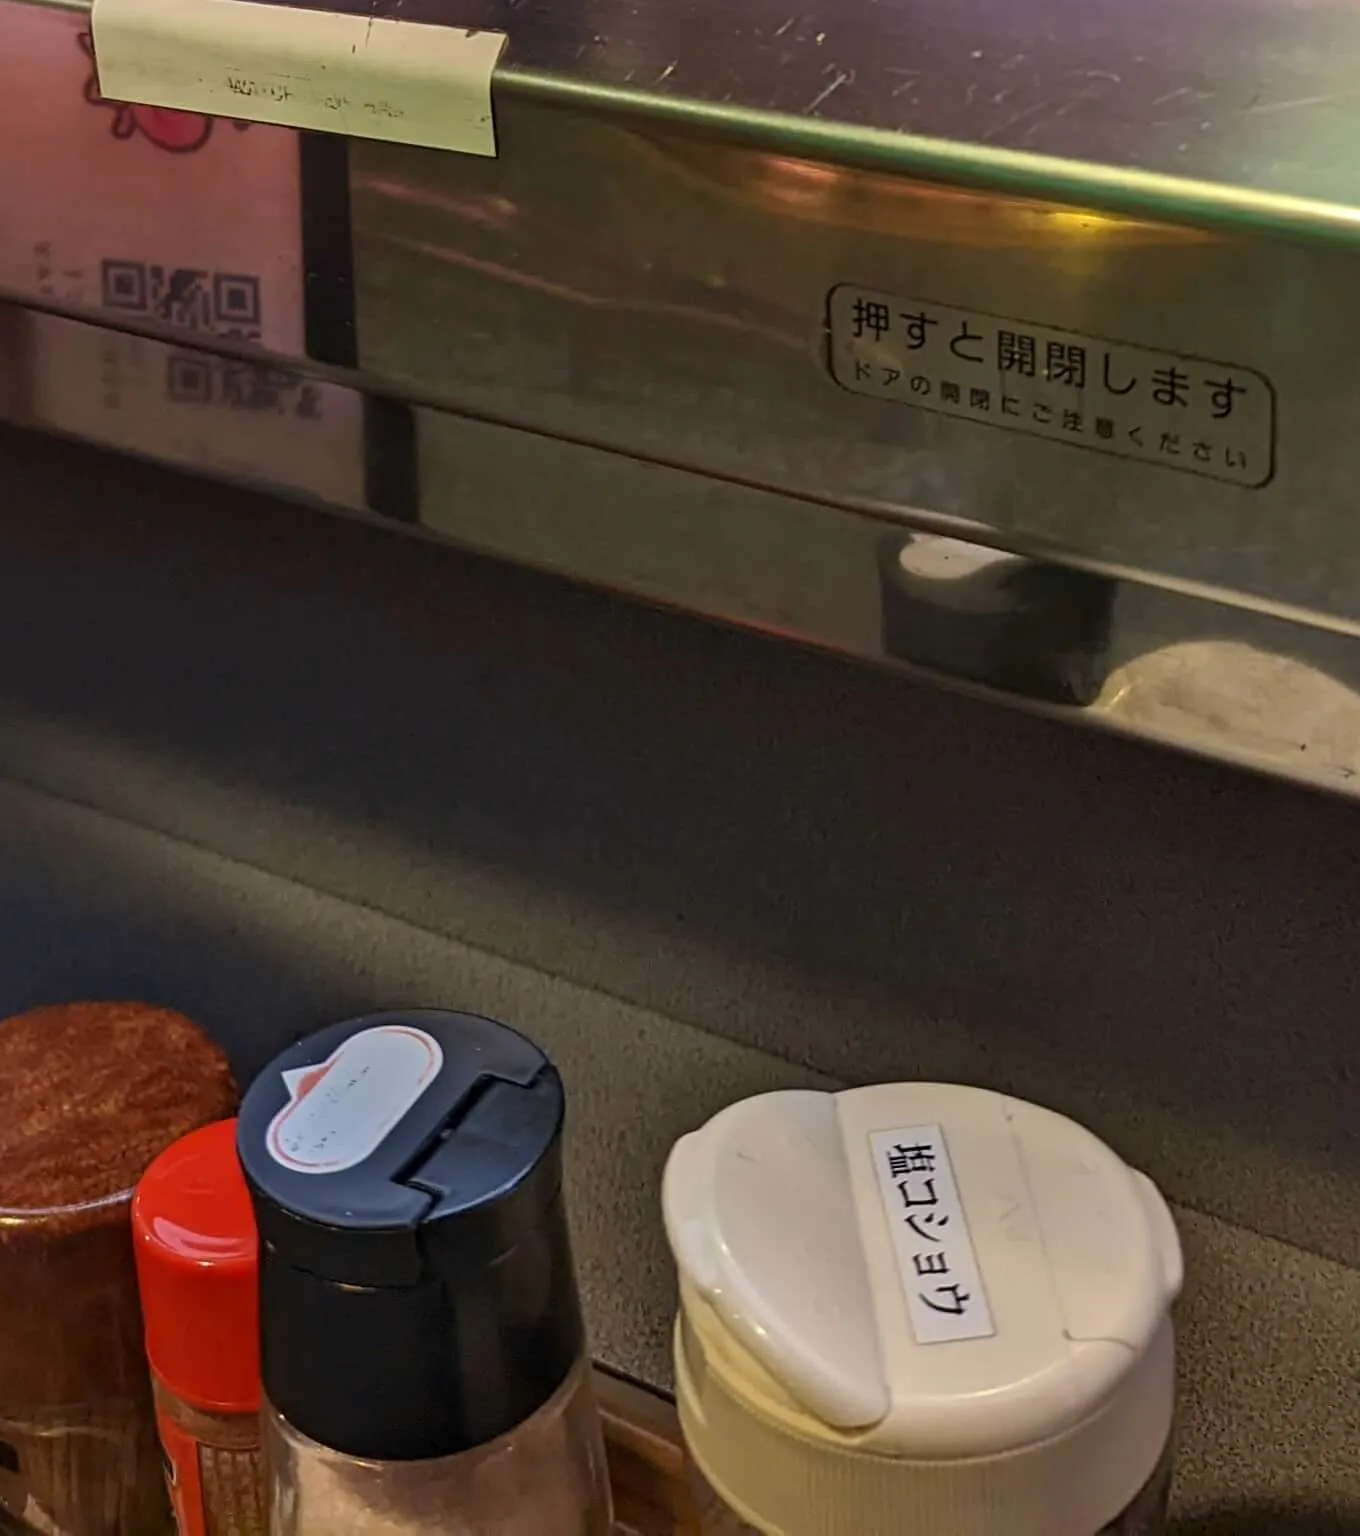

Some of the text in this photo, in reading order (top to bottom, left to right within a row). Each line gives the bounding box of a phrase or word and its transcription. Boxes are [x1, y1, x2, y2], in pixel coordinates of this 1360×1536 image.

[852, 297, 1247, 419] 押すと開閉します
[853, 359, 1248, 470] ドアの開閉にご注意ください
[886, 1143, 971, 1316] 塩コショウ
